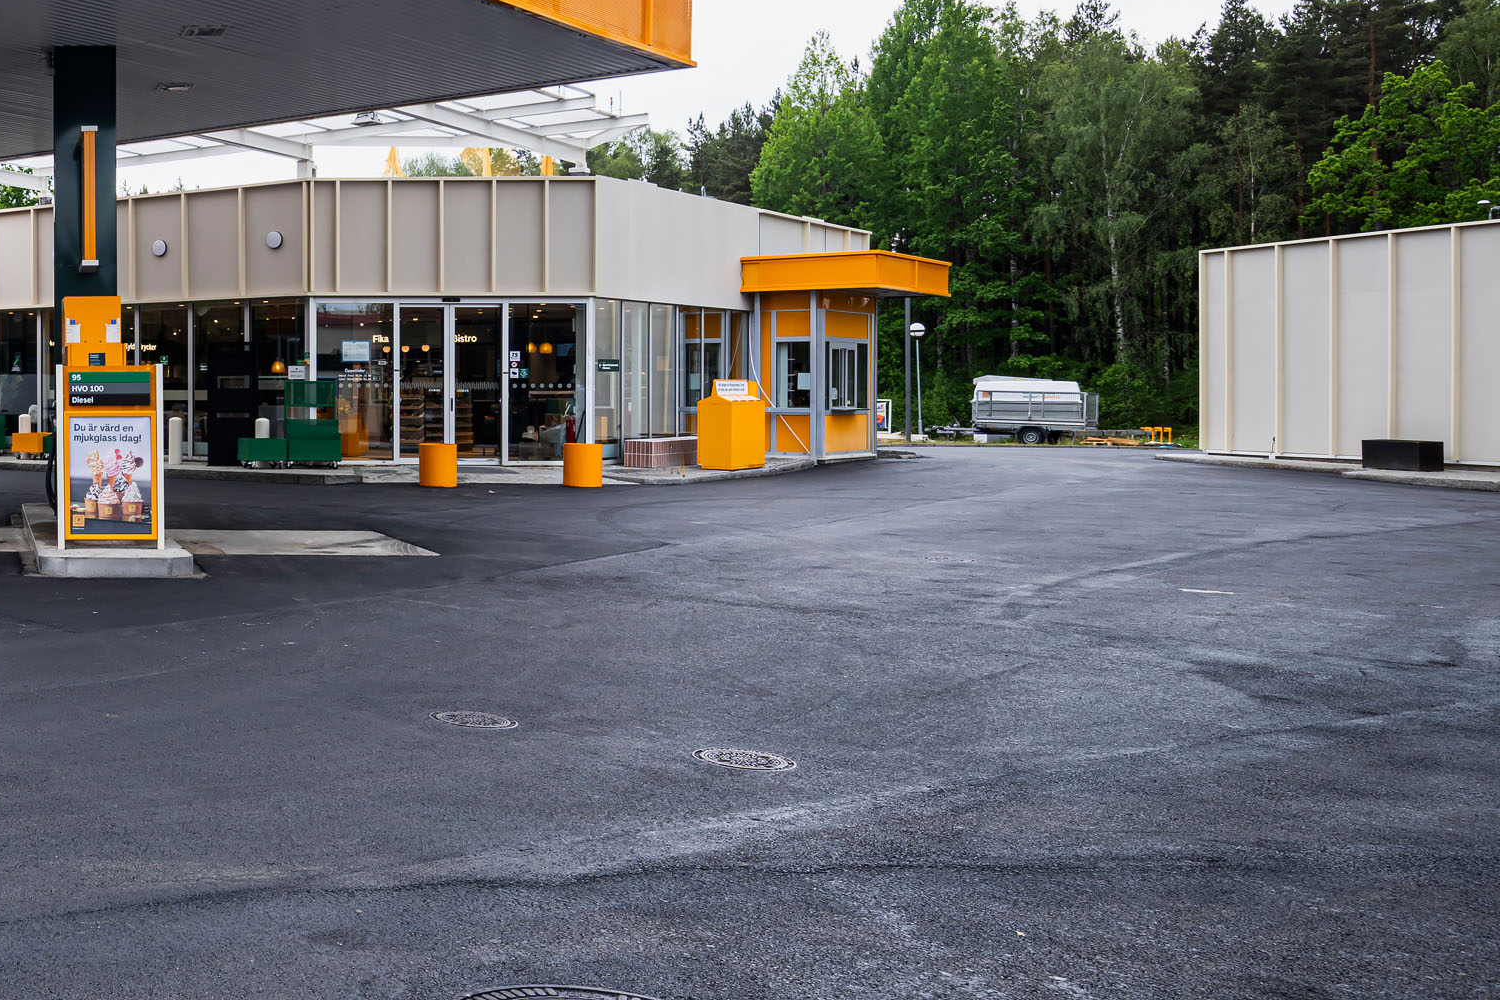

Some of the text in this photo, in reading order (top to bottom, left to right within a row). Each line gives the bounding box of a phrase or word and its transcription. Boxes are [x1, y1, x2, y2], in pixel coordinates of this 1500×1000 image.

[372, 334, 389, 343] Fika
[71, 396, 94, 404] Diesel
[73, 423, 86, 432] Du
[88, 423, 98, 432] är
[99, 423, 120, 432] värd
[73, 434, 142, 444] mjukglass idag!
